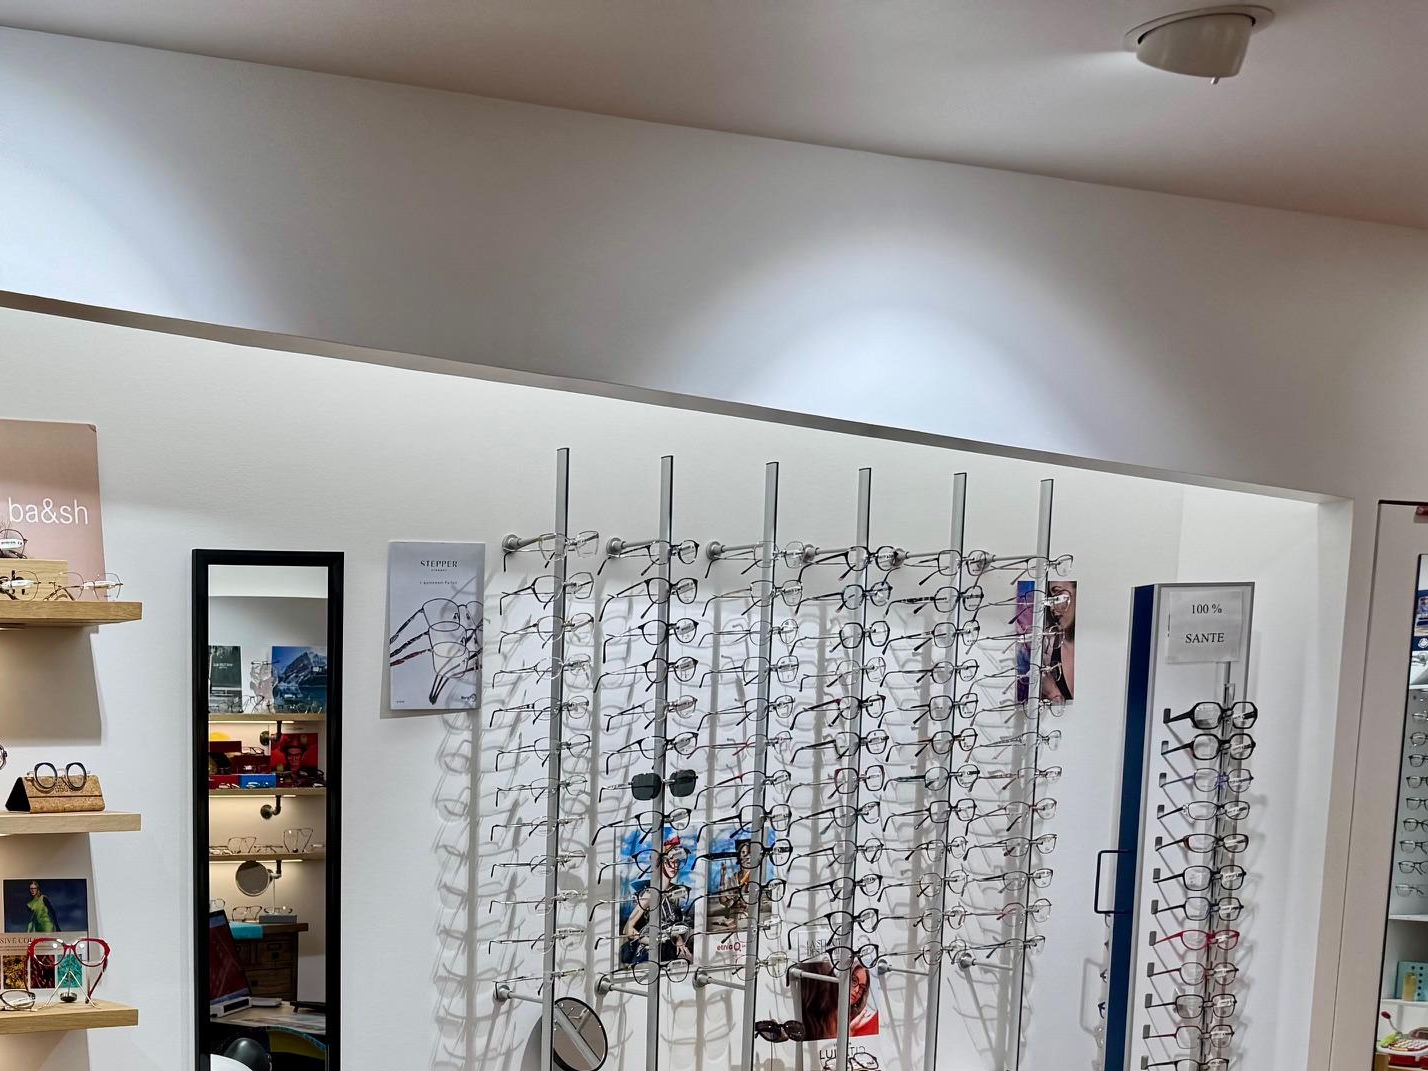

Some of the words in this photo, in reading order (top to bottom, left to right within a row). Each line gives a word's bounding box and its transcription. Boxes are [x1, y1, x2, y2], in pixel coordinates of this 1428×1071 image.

[8, 497, 89, 525] ba&sh
[420, 560, 459, 568] STEPPER
[1191, 603, 1209, 614] 100
[1211, 603, 1223, 614] %
[1184, 632, 1225, 644] SANTE
